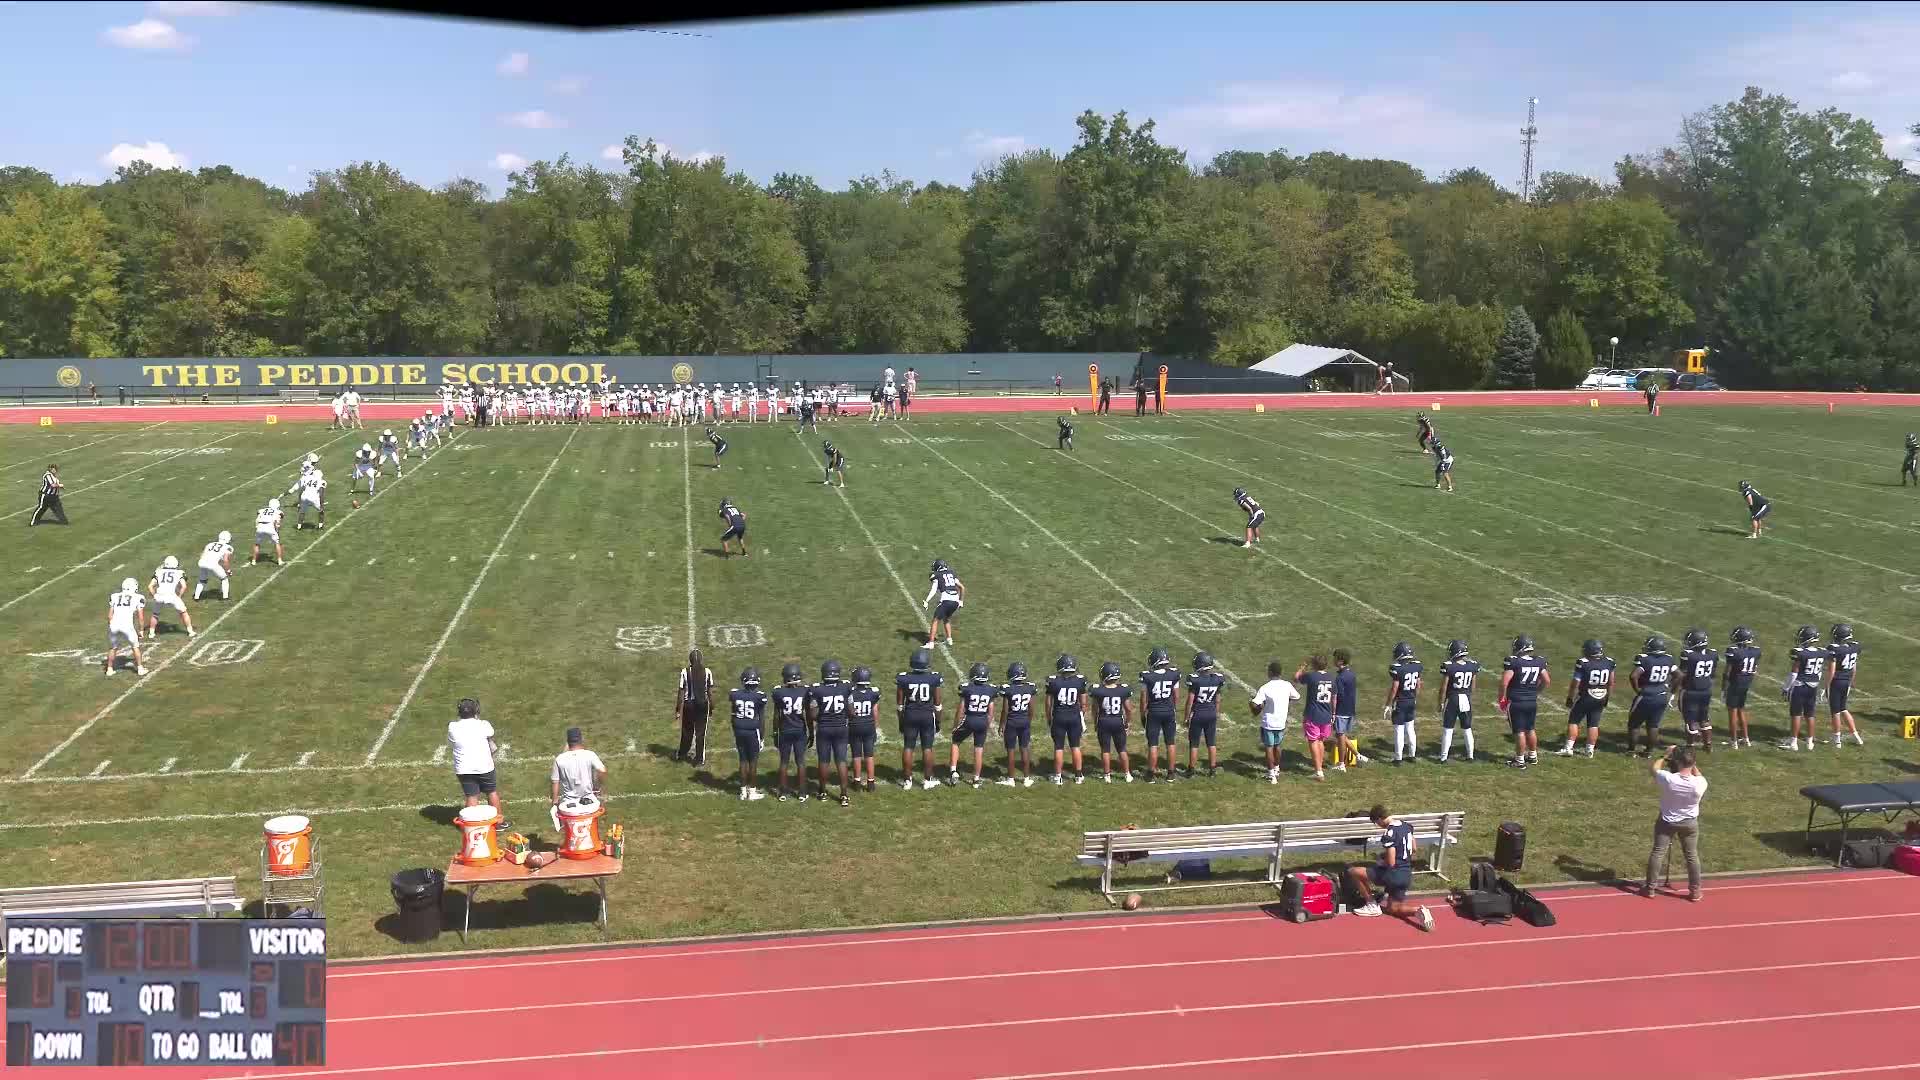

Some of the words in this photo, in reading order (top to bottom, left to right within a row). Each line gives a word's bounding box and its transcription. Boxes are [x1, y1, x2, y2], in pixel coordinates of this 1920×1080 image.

[143, 365, 241, 387] THE
[258, 364, 426, 386] PEDDIE
[442, 363, 616, 385] SCHOOL
[160, 571, 175, 584] 15
[116, 594, 132, 607] 13
[1694, 660, 1714, 678] 63
[1741, 657, 1756, 673] 11
[1805, 657, 1825, 676] 56
[1841, 653, 1858, 670] 42
[1453, 671, 1473, 689] 30
[1521, 666, 1540, 685] 77
[1588, 668, 1610, 686] 60
[1649, 665, 1670, 683] 68
[908, 683, 930, 702] 70
[1057, 687, 1078, 706] 40
[1151, 680, 1173, 699] 45
[1198, 686, 1218, 704] 57
[735, 699, 755, 720] 36
[782, 696, 803, 716] 34
[822, 694, 845, 714] 76
[968, 694, 991, 713] 22
[1011, 693, 1032, 712] 32
[1101, 696, 1121, 715] 48
